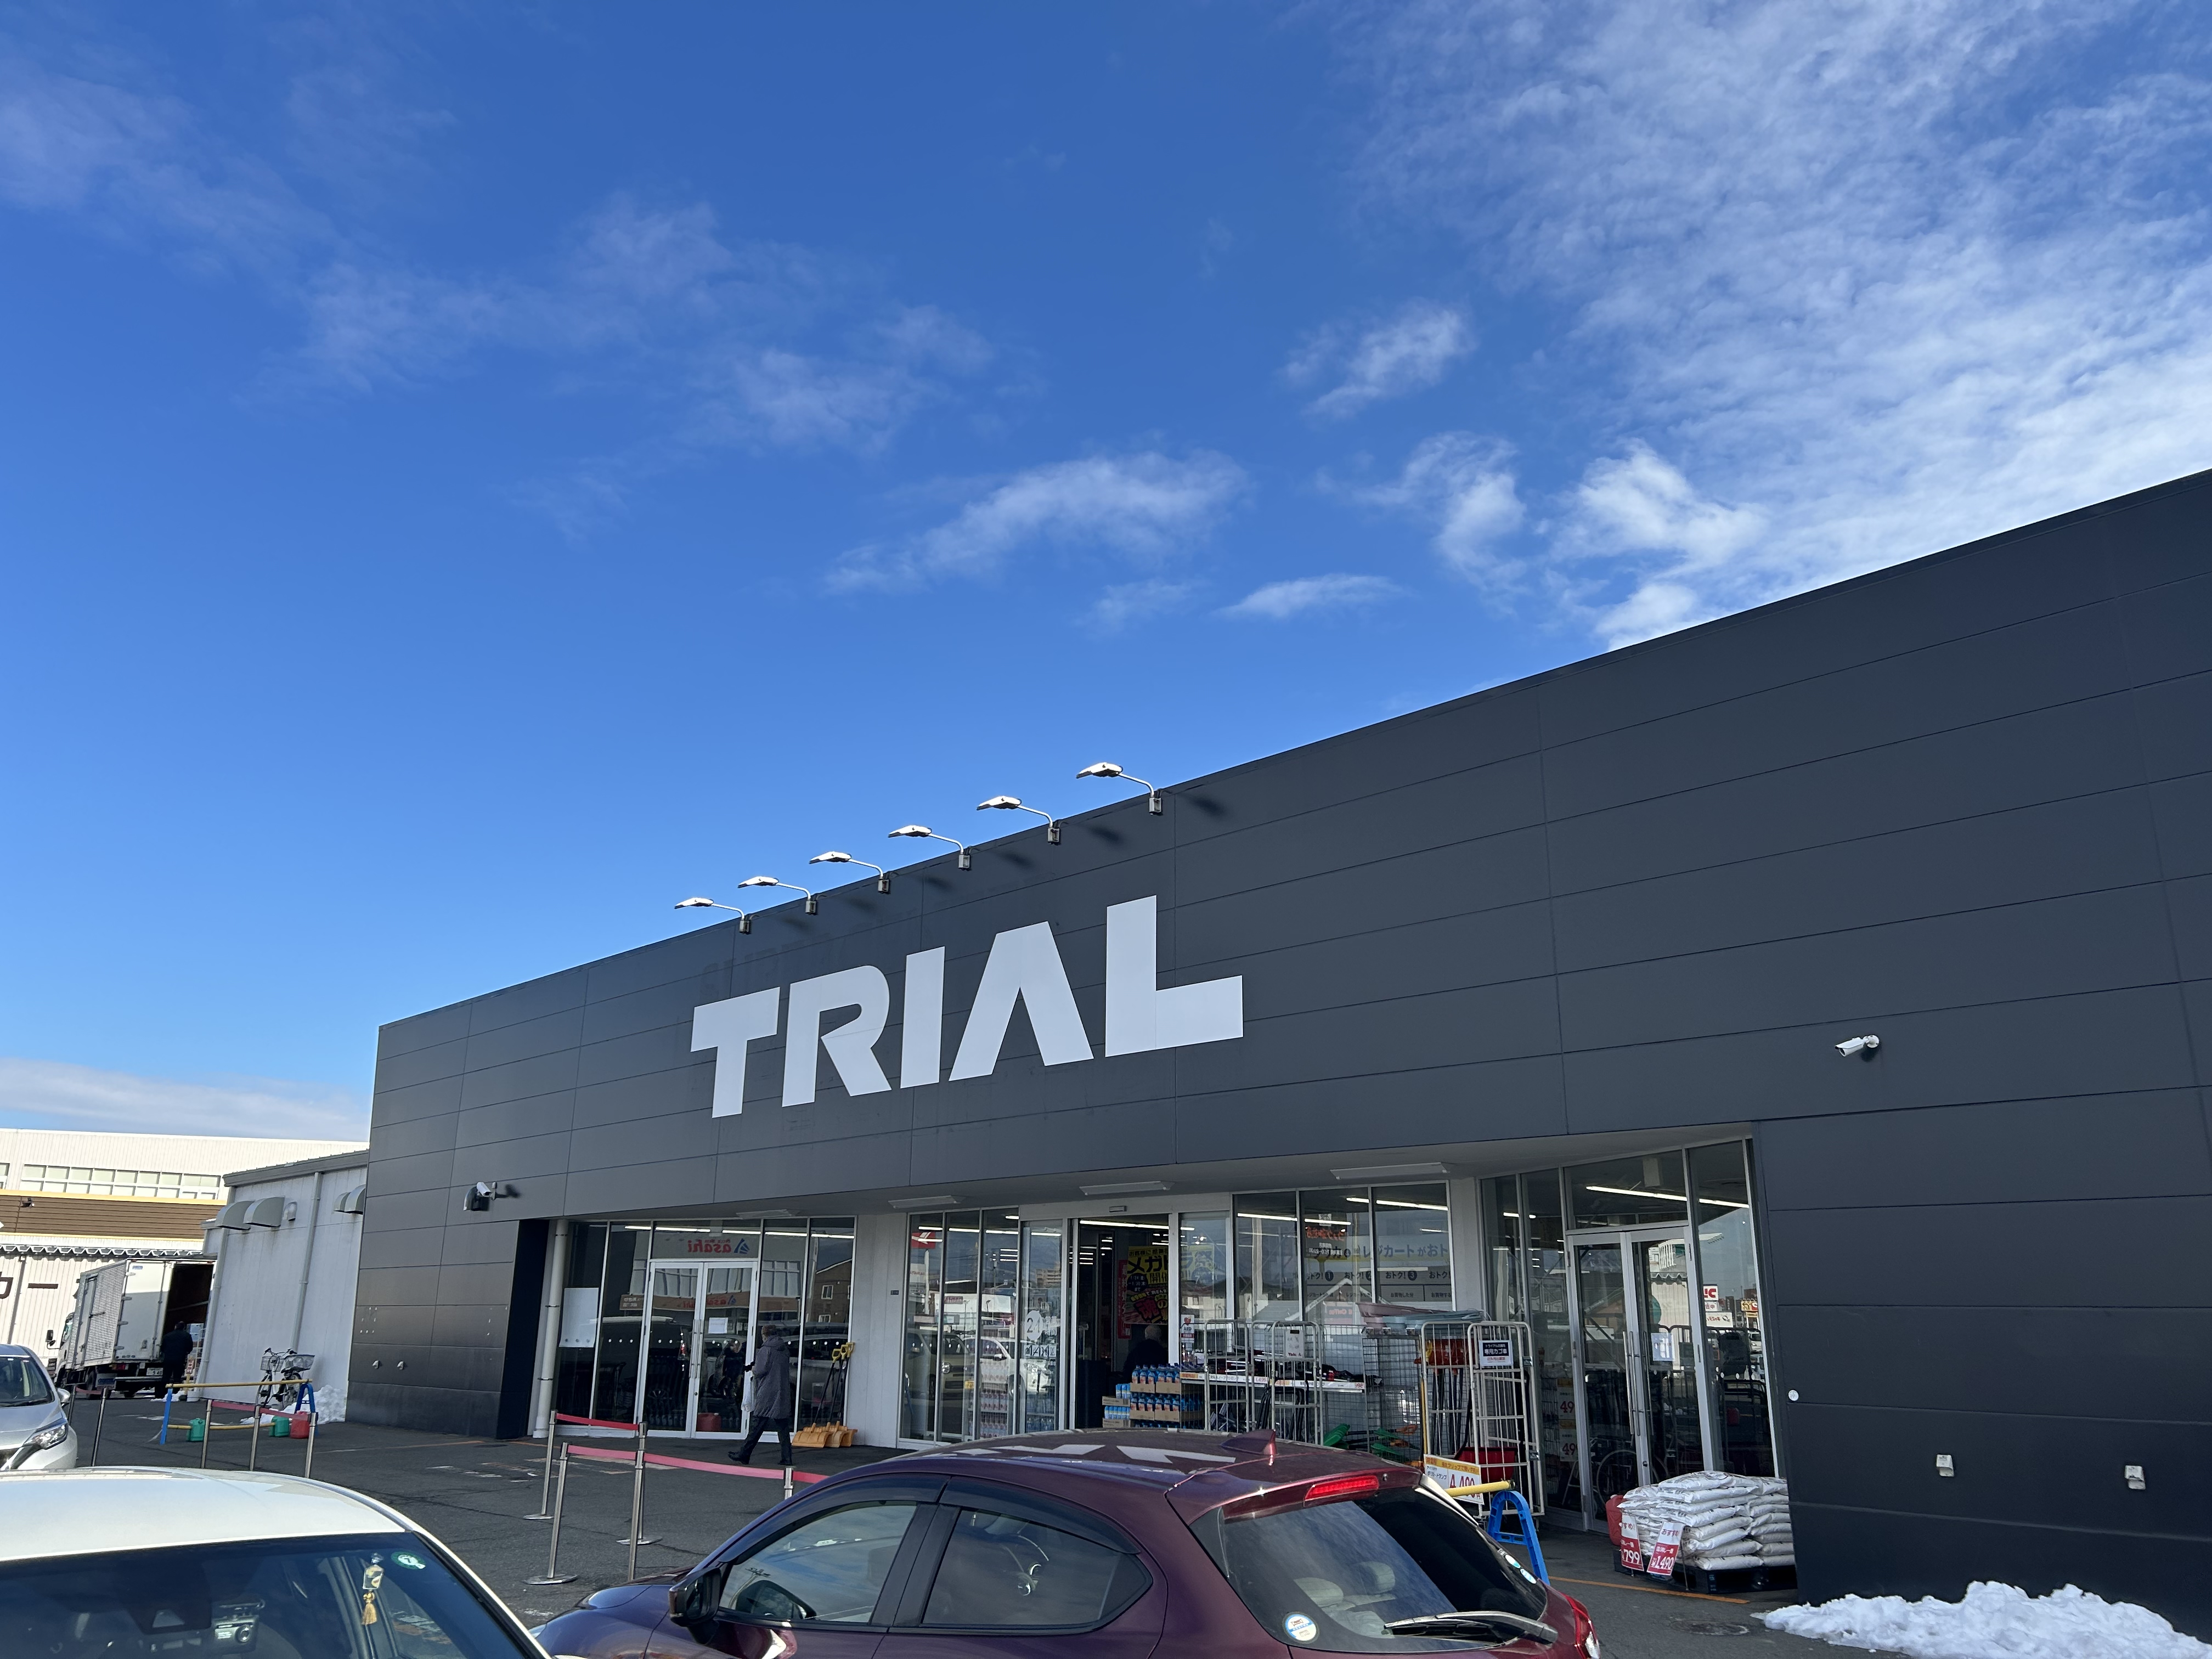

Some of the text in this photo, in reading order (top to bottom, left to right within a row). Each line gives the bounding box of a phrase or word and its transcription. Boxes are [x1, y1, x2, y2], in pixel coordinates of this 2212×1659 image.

[691, 895, 1244, 1118] TRIAL
[1385, 1271, 1406, 1279] おトク!
